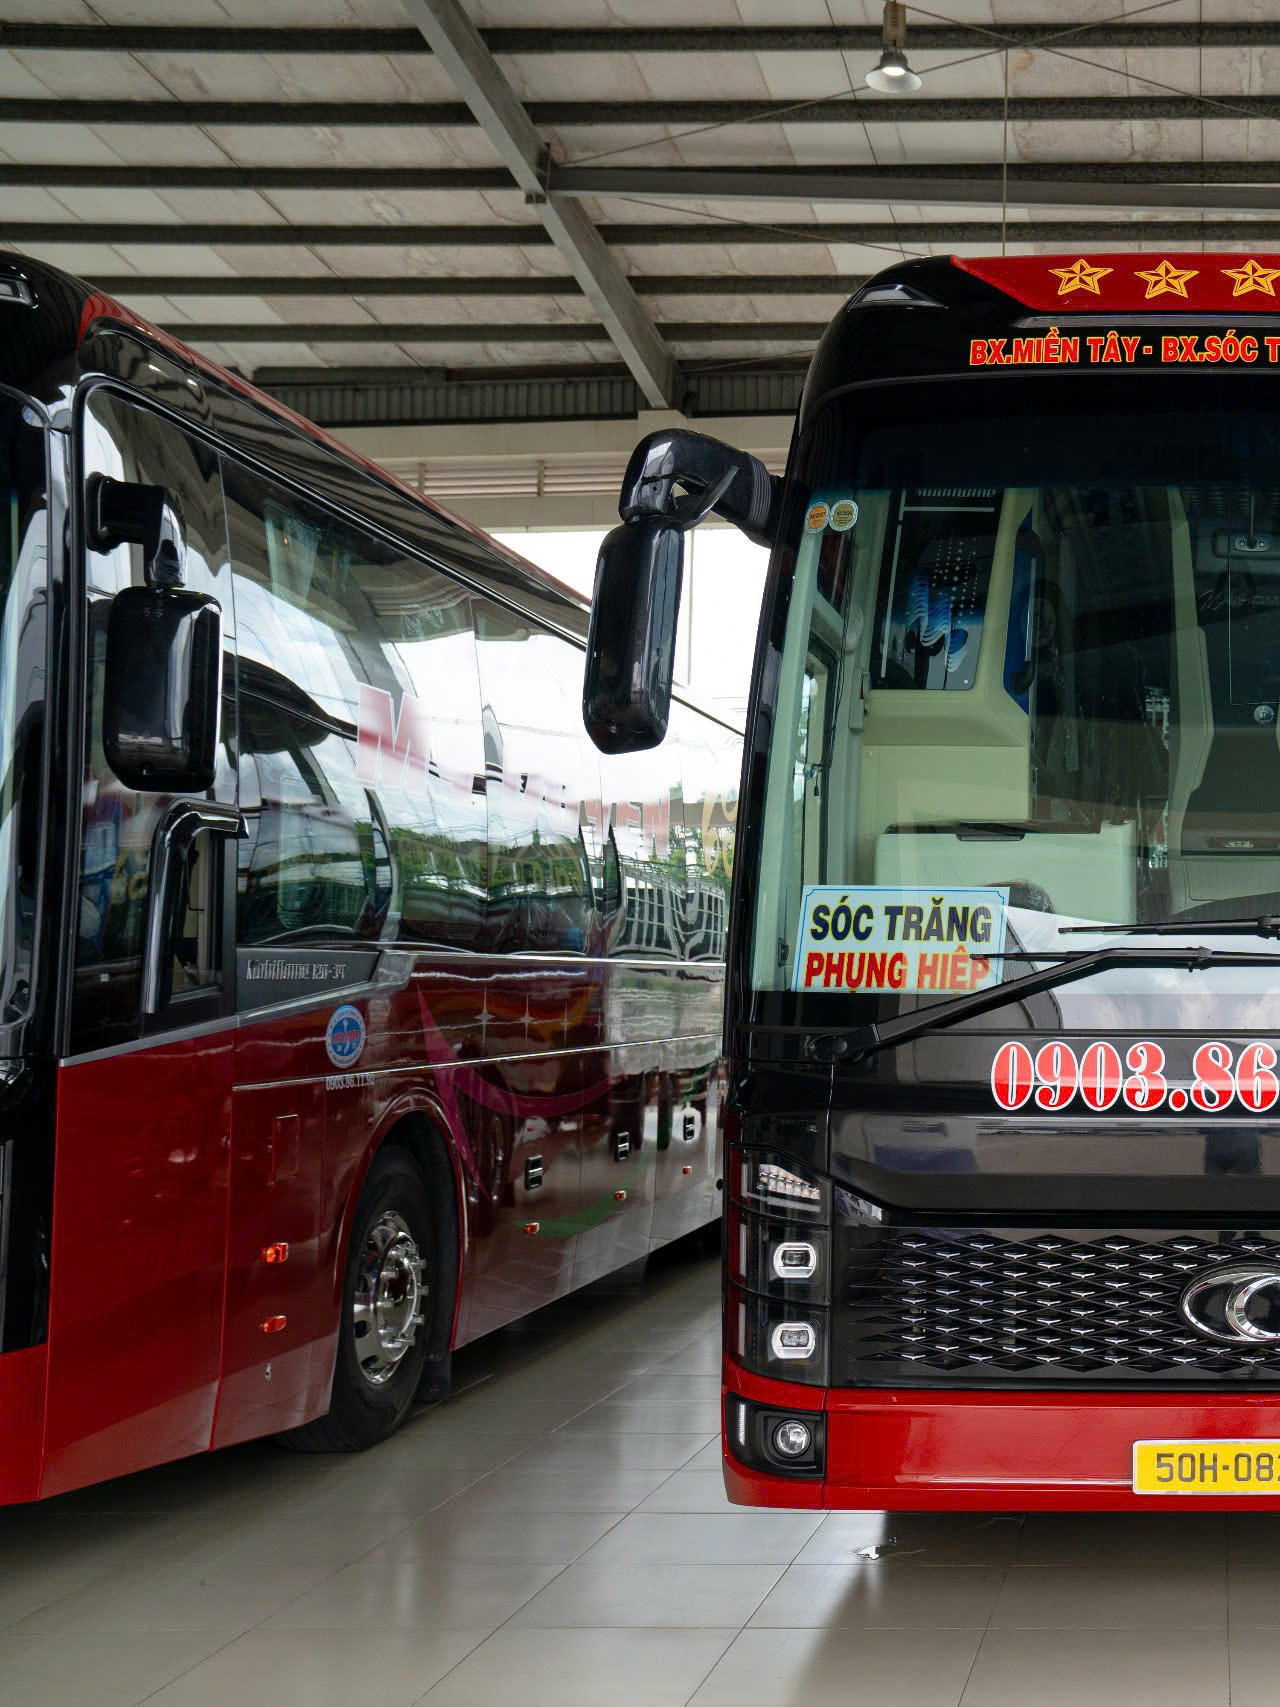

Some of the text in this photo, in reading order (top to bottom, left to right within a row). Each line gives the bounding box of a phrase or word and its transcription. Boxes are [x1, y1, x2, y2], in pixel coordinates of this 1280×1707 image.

[969, 327, 1079, 365] BX.MIỀN
[1087, 331, 1140, 363] TÂY
[1161, 330, 1258, 363] BX.SÓC
[810, 895, 992, 943] SÓC TRĂNG
